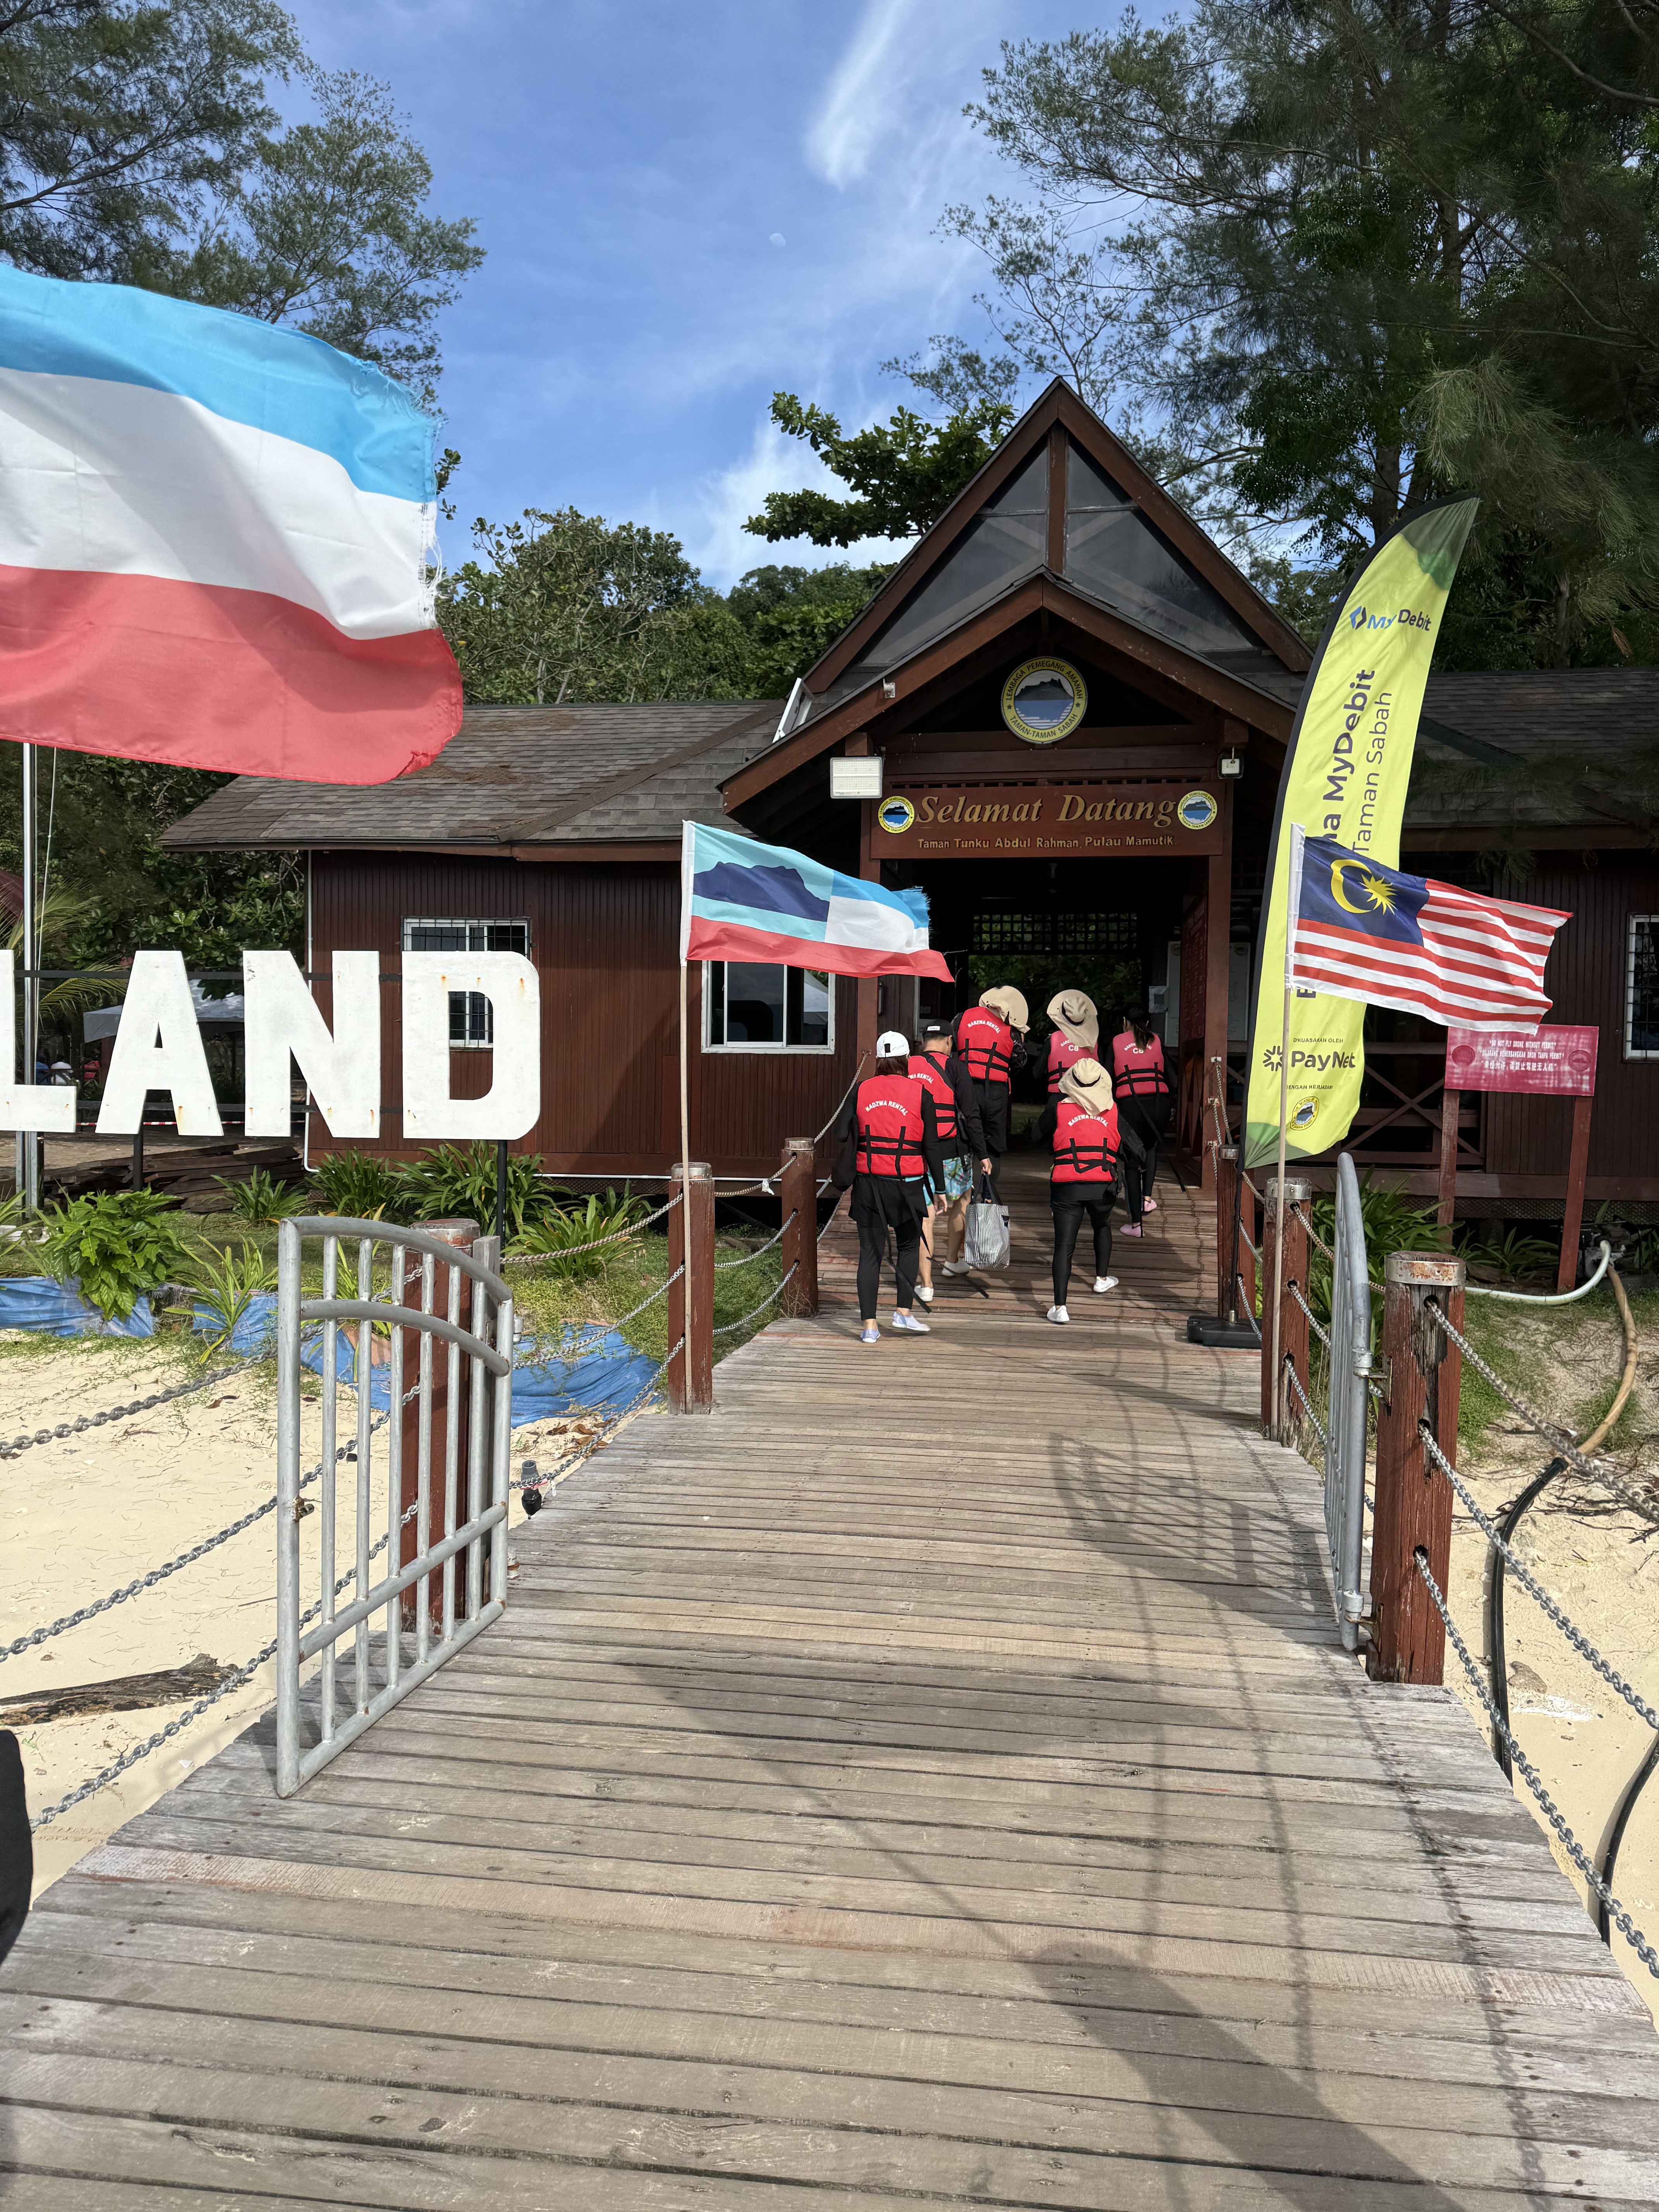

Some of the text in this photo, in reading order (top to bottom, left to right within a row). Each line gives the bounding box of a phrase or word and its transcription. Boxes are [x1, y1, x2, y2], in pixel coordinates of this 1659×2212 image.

[1367, 609, 1431, 631] MyDebit
[1006, 661, 1083, 700] LEMBAGA PEMEGANG AMANAH
[1010, 714, 1078, 738] TAMAN-TAMAN SABAH
[1323, 669, 1375, 801] MyDebit
[1352, 692, 1392, 852] Taman Sabah
[915, 795, 1176, 828] Selamat Datang
[918, 836, 1177, 849] Taman Tunku Abdul Rahman, Pulau Mamutik.
[986, 1021, 1001, 1034] RENTAL
[0, 949, 540, 1139] LAND
[1291, 1051, 1355, 1071] PayNet
[917, 1073, 934, 1084] RENTAL
[865, 1100, 908, 1116] NADZWA RENTAL
[1068, 1114, 1089, 1126] NADZWA
